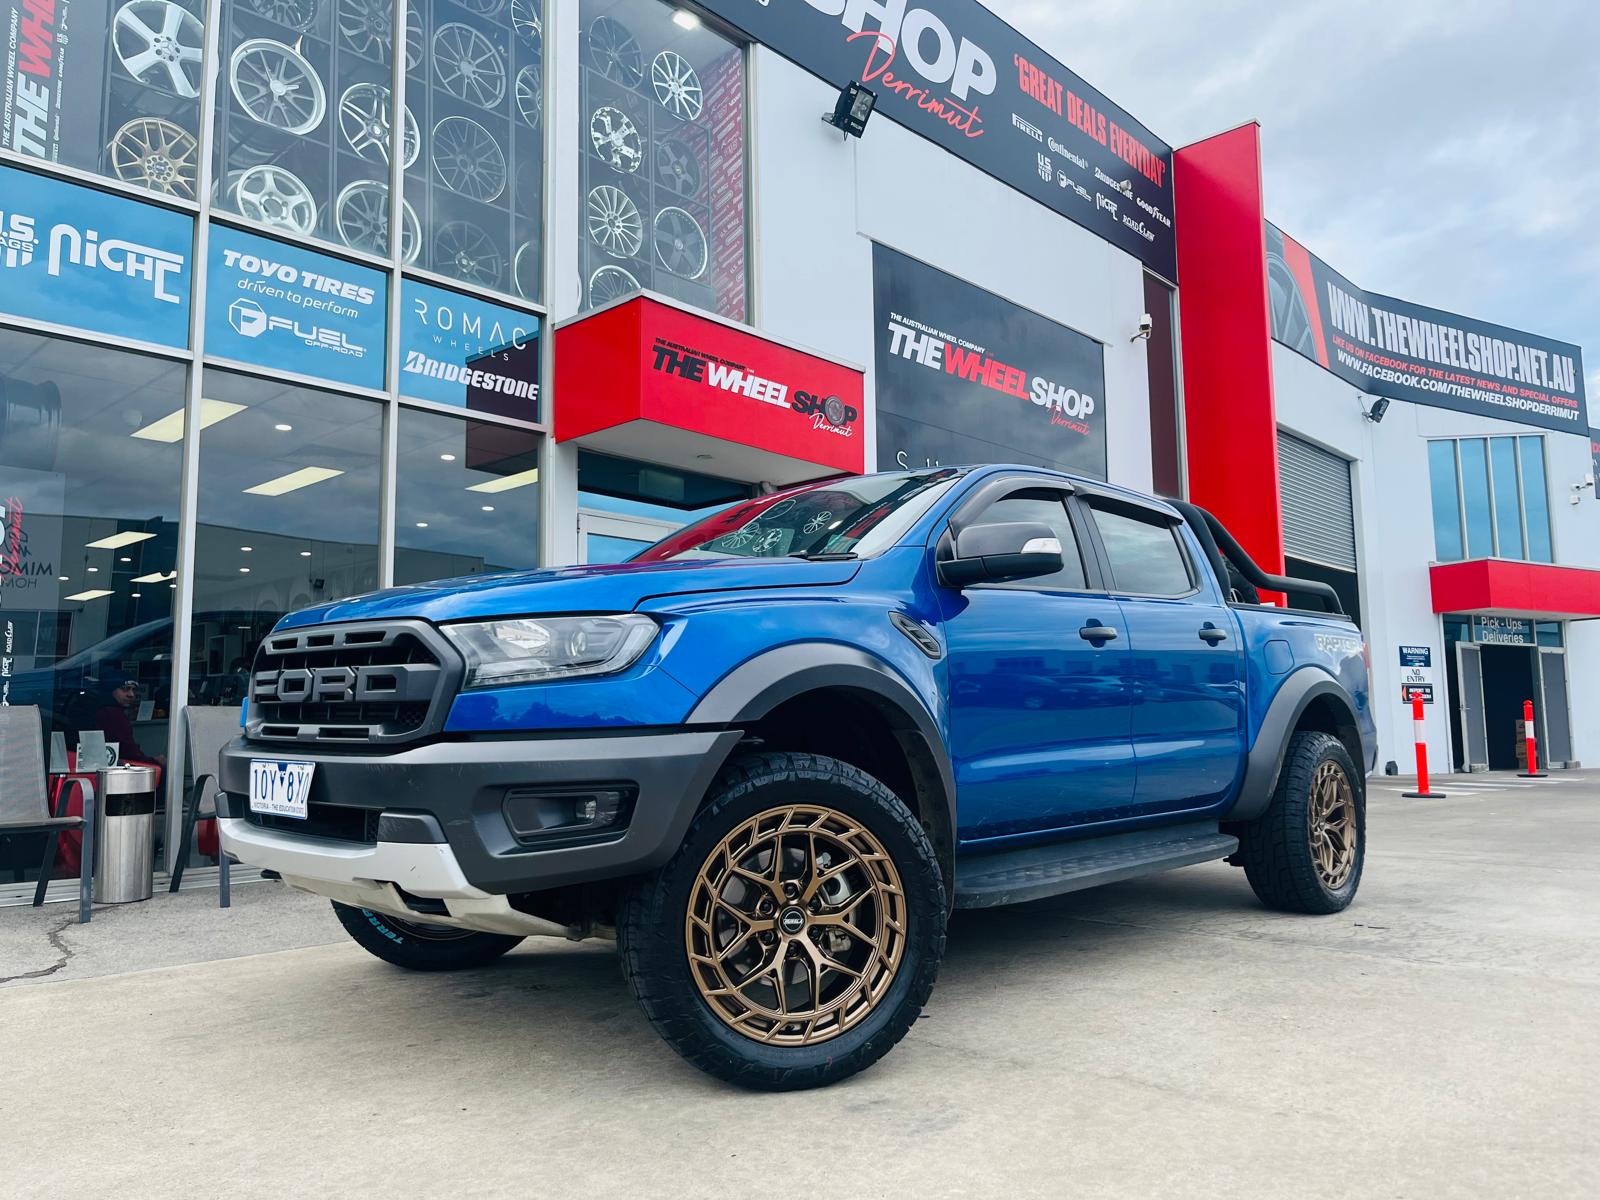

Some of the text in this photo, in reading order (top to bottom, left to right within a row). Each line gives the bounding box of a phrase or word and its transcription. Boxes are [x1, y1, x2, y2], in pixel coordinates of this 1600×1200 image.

[8, 8, 19, 48] COMPANY
[7, 51, 16, 80] WHEEL
[803, 0, 997, 101] HOP
[4, 80, 13, 127] AUSTRALIAN
[846, 31, 985, 138] Derrimut
[13, 72, 50, 158] THE
[1012, 112, 1043, 143] PIRELLI
[1066, 90, 1107, 146] DEALS
[0, 236, 34, 253] AGS
[223, 249, 376, 305] TOYO TIRES
[237, 278, 358, 319] driven to perform
[269, 316, 365, 352] FUEL
[415, 298, 527, 350] ROMAC
[890, 312, 985, 354] THE AUSTRALIAN WHEEL COMPANY
[1327, 281, 1576, 394] WWW.THEWHEELSHOP.NET.AU
[433, 335, 509, 360] WHEELS
[402, 350, 539, 400] BRIDGESTONE
[653, 344, 858, 428] THE WHEEL SHOP
[888, 321, 1095, 420] THE WHEEL SHOP
[1332, 335, 1577, 408] LIKE US ON FACEBOOK FOR THE LATEST NEWS AND SPECIAL OFFERS
[1338, 349, 1580, 420] WWW.FACEBOOK.COM/THEWHEELSHOPDERRIMUT
[808, 412, 853, 437] Derrimut
[1481, 616, 1499, 629] Pick
[1506, 618, 1522, 633] Ups
[1482, 630, 1524, 644] Deliveries
[1402, 647, 1429, 655] WARNING
[254, 665, 406, 703] FORD
